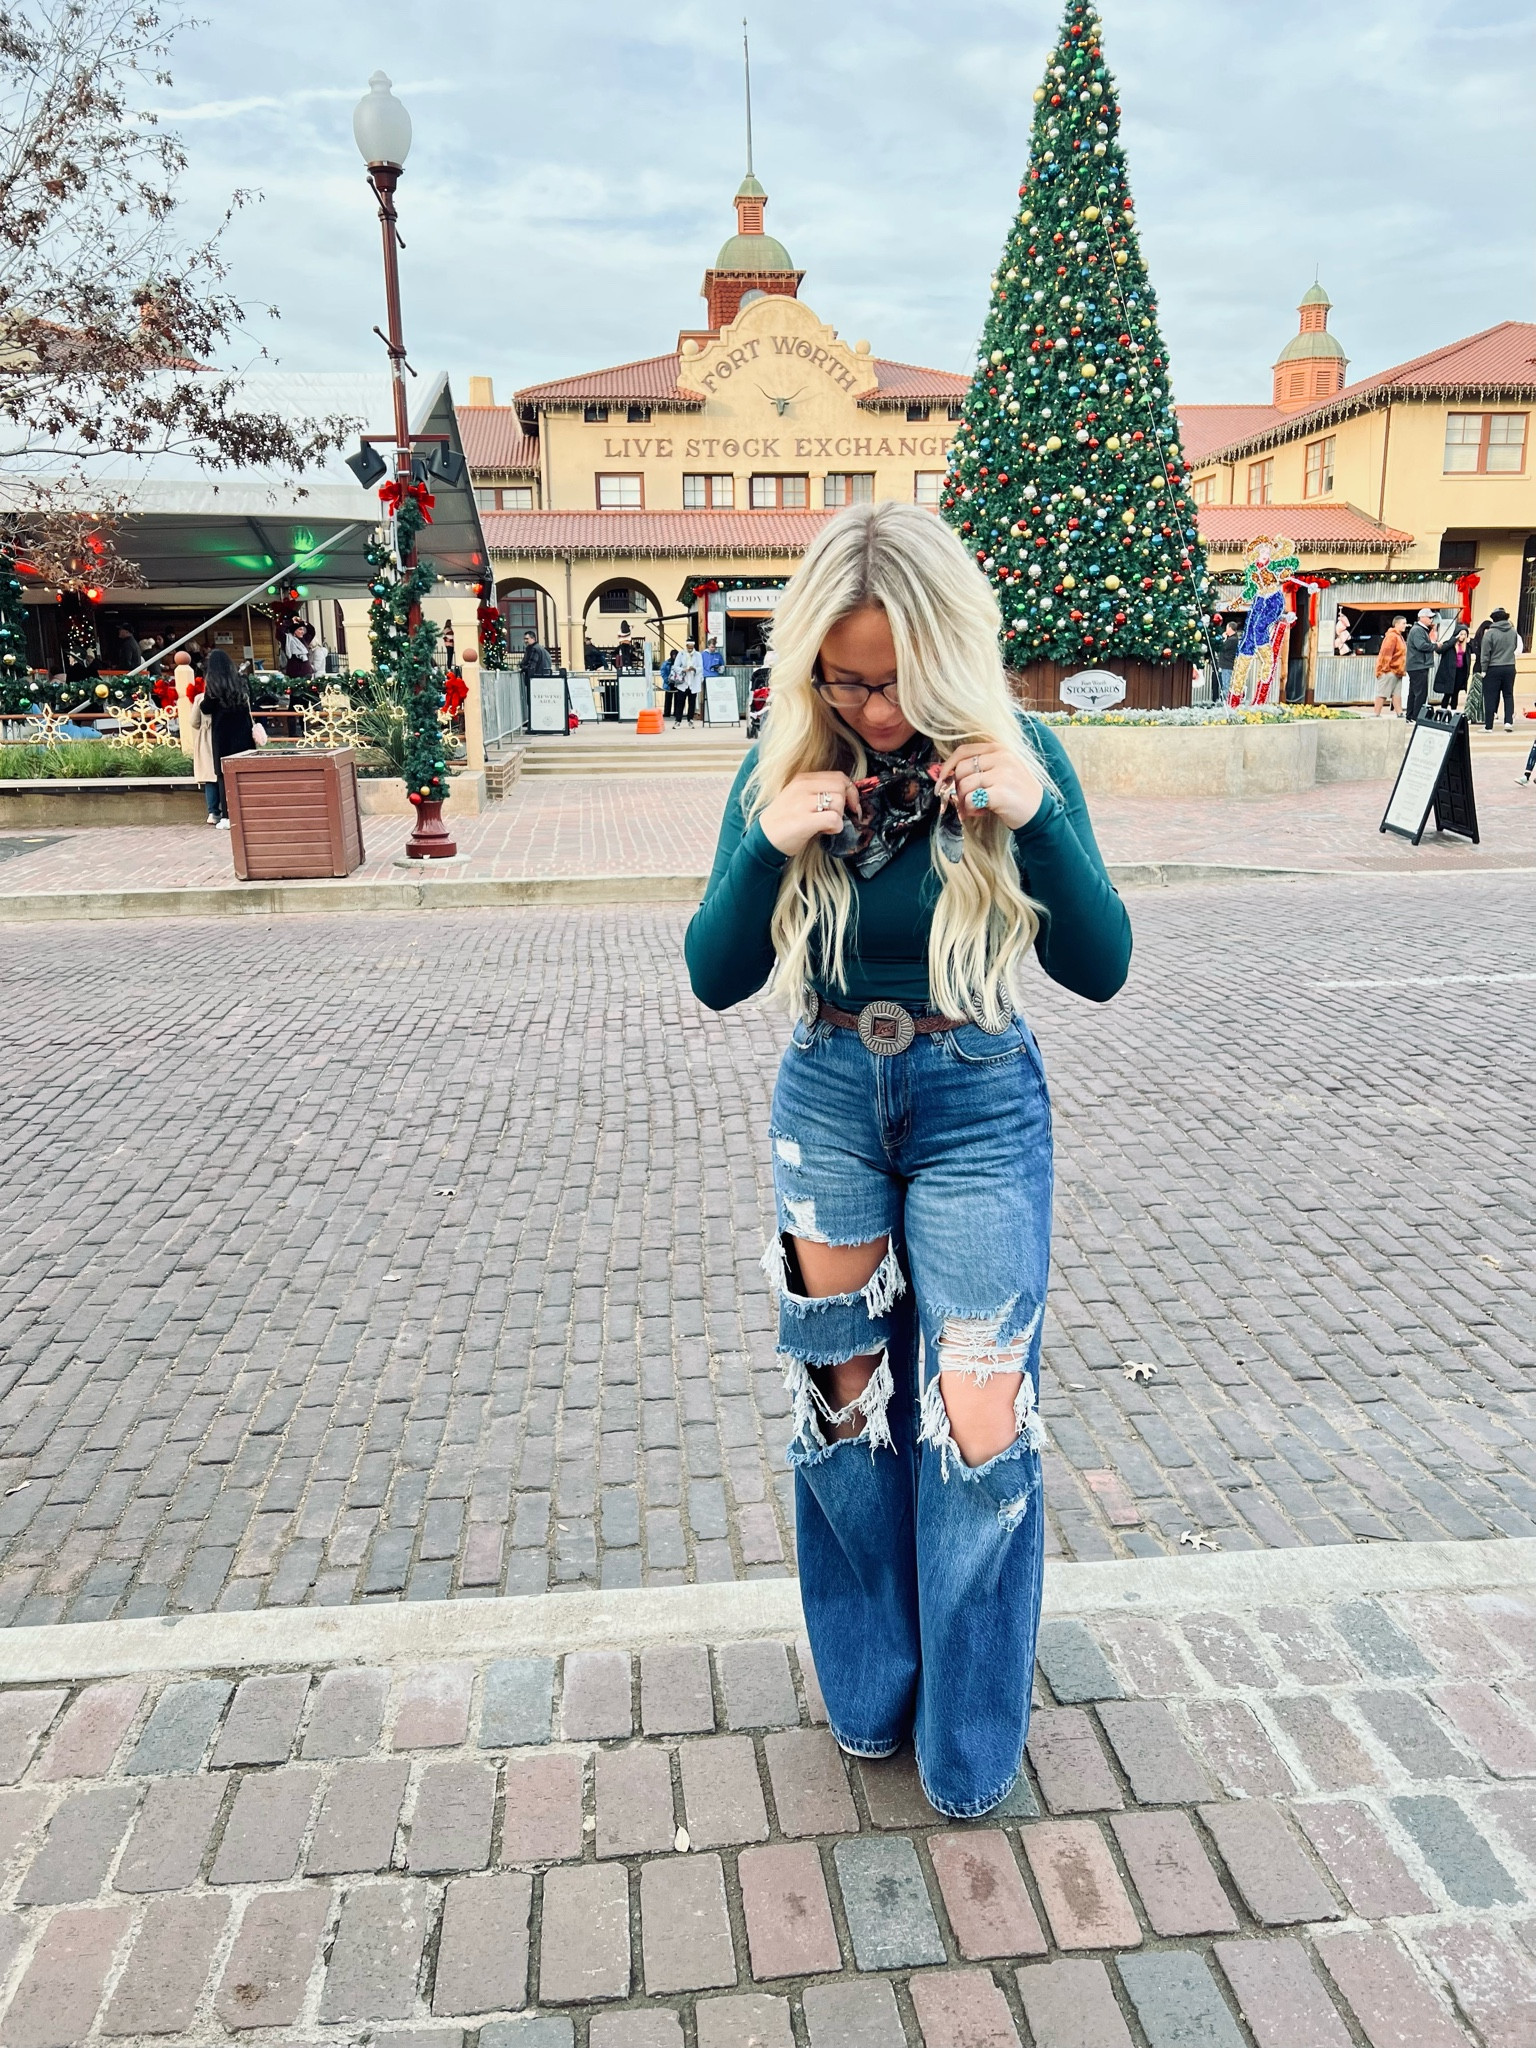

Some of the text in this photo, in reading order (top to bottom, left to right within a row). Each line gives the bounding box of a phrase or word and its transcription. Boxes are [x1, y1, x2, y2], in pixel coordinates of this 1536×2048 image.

[701, 335, 858, 394] FORT WORTH
[604, 437, 954, 458] LIVE STOCK EXCHANGE
[1066, 685, 1120, 694] STOCKYARDS
